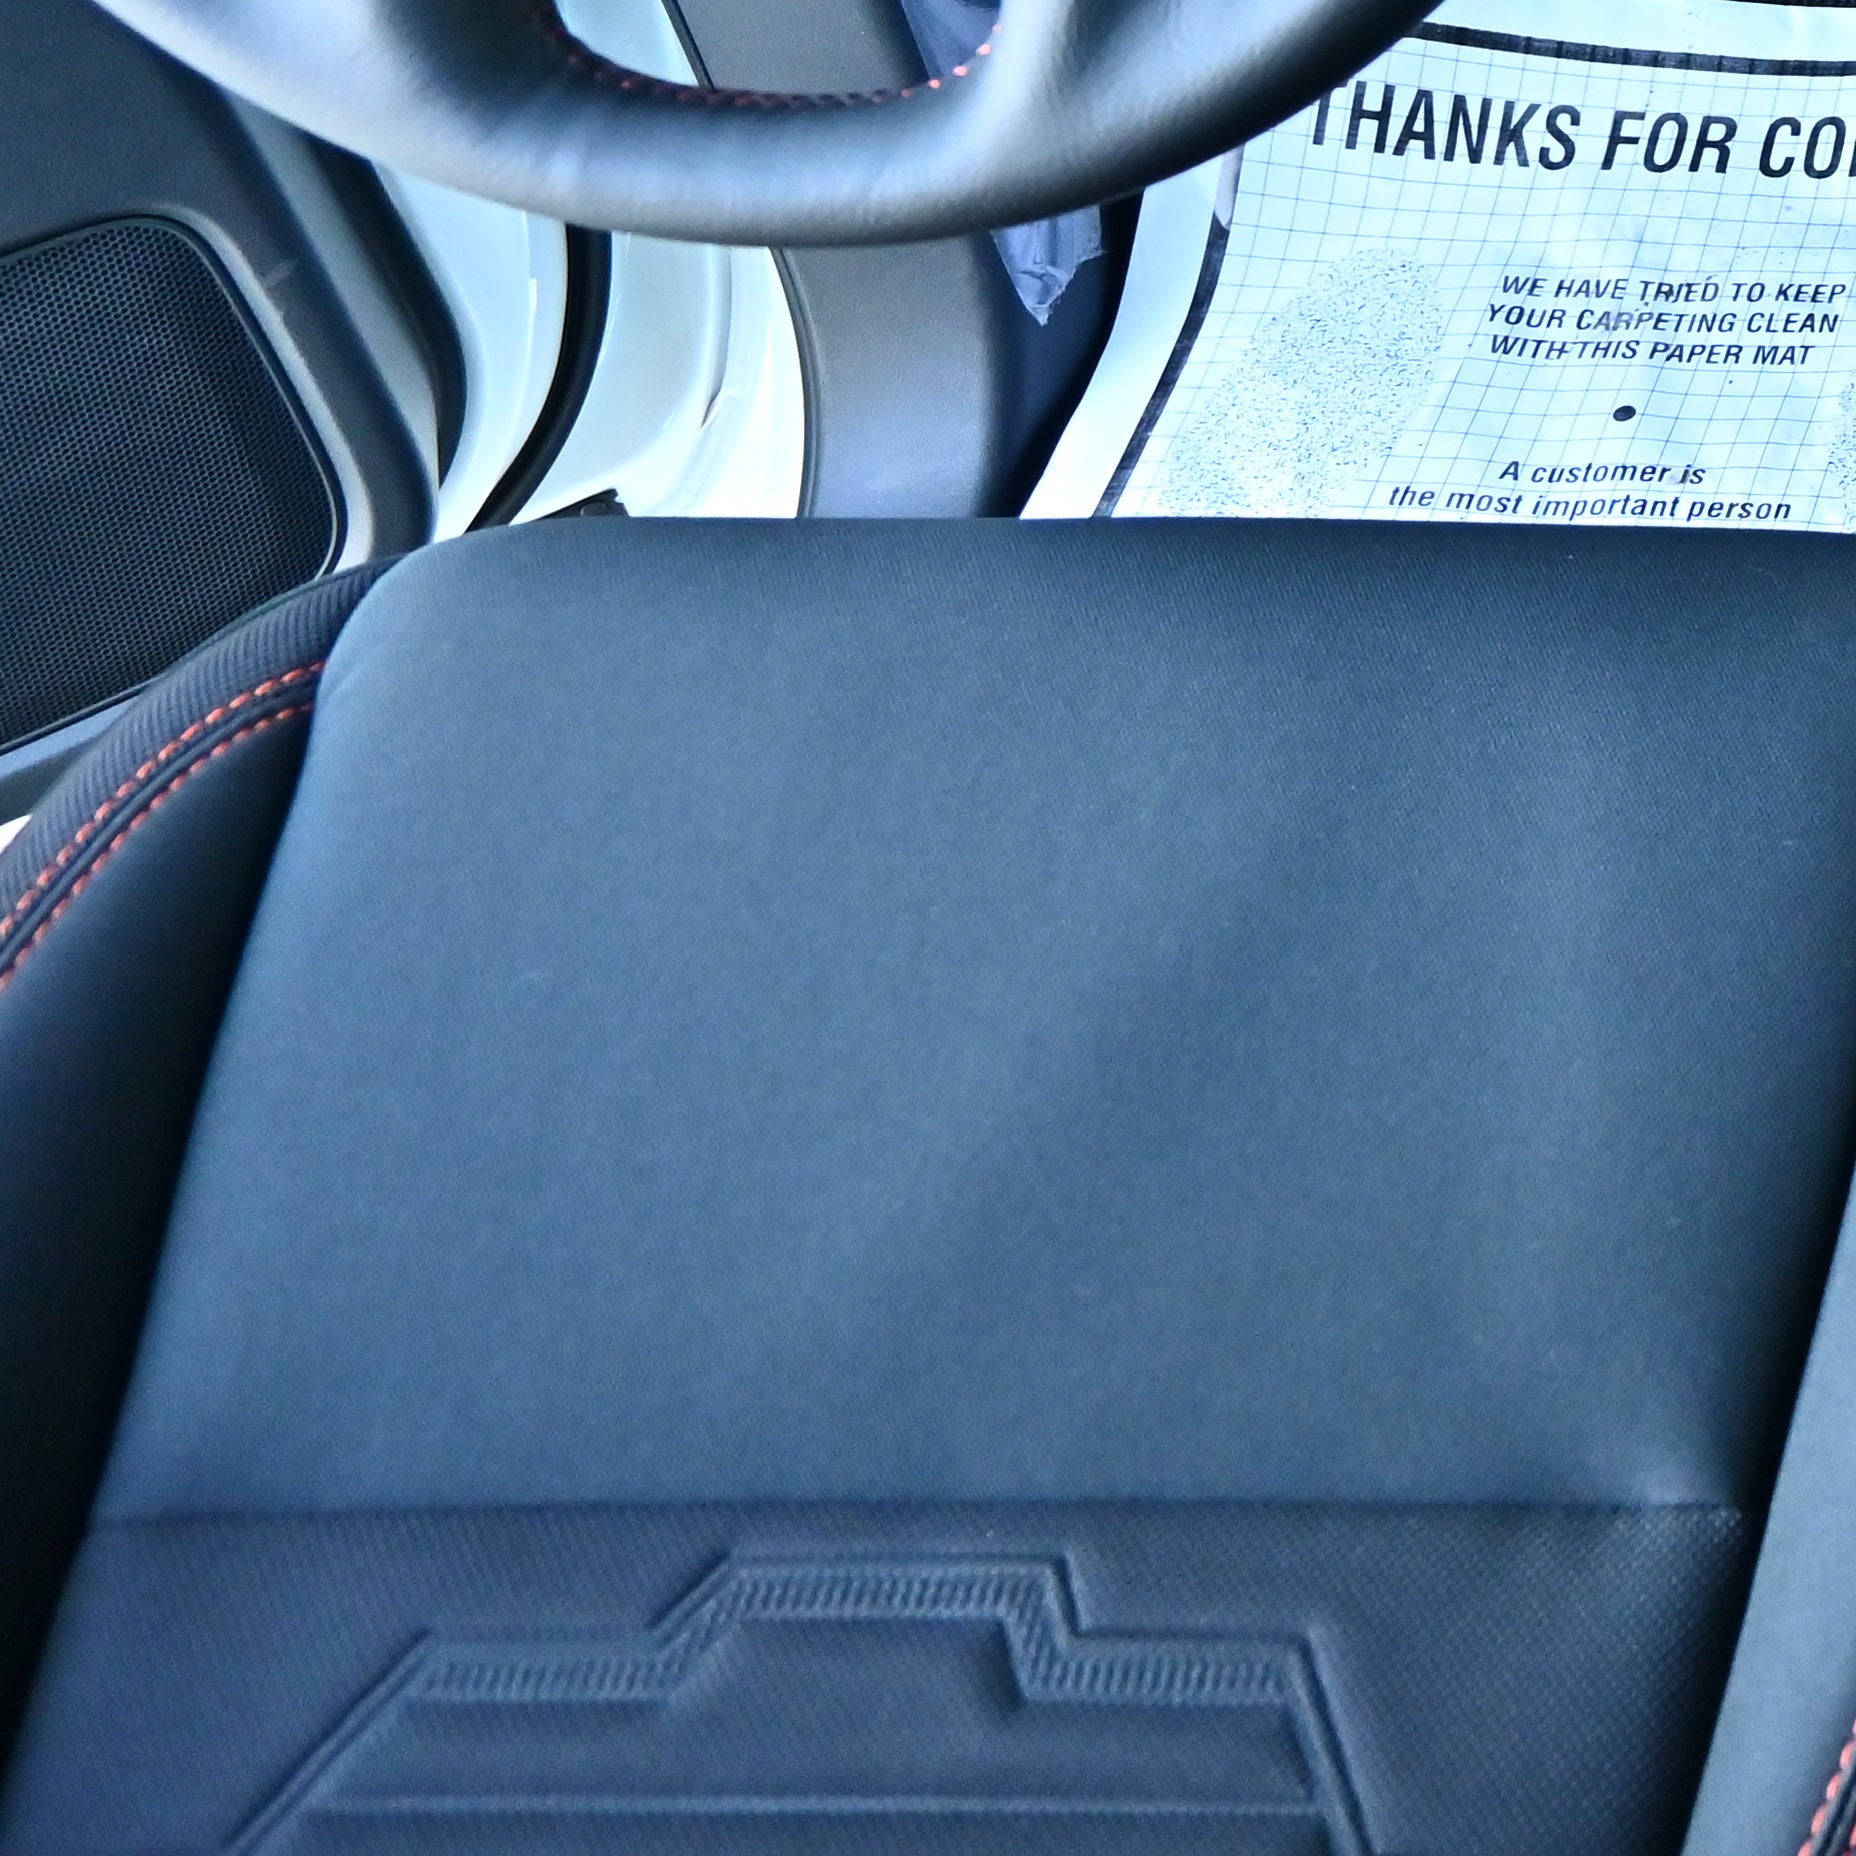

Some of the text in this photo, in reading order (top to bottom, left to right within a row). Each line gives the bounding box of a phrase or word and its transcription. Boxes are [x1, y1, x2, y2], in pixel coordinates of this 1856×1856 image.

[1312, 81, 1581, 171] THANKS
[1601, 110, 1738, 174] FOR
[1502, 275, 1846, 304] WE HAVE TRIED TO KEEP
[1488, 304, 1839, 333] YOUR CARPETING CLEAN
[1490, 334, 1815, 365] WITH THIS PAPER MAT
[1499, 461, 1706, 484] A customer is
[1389, 486, 1791, 522] the most important person
